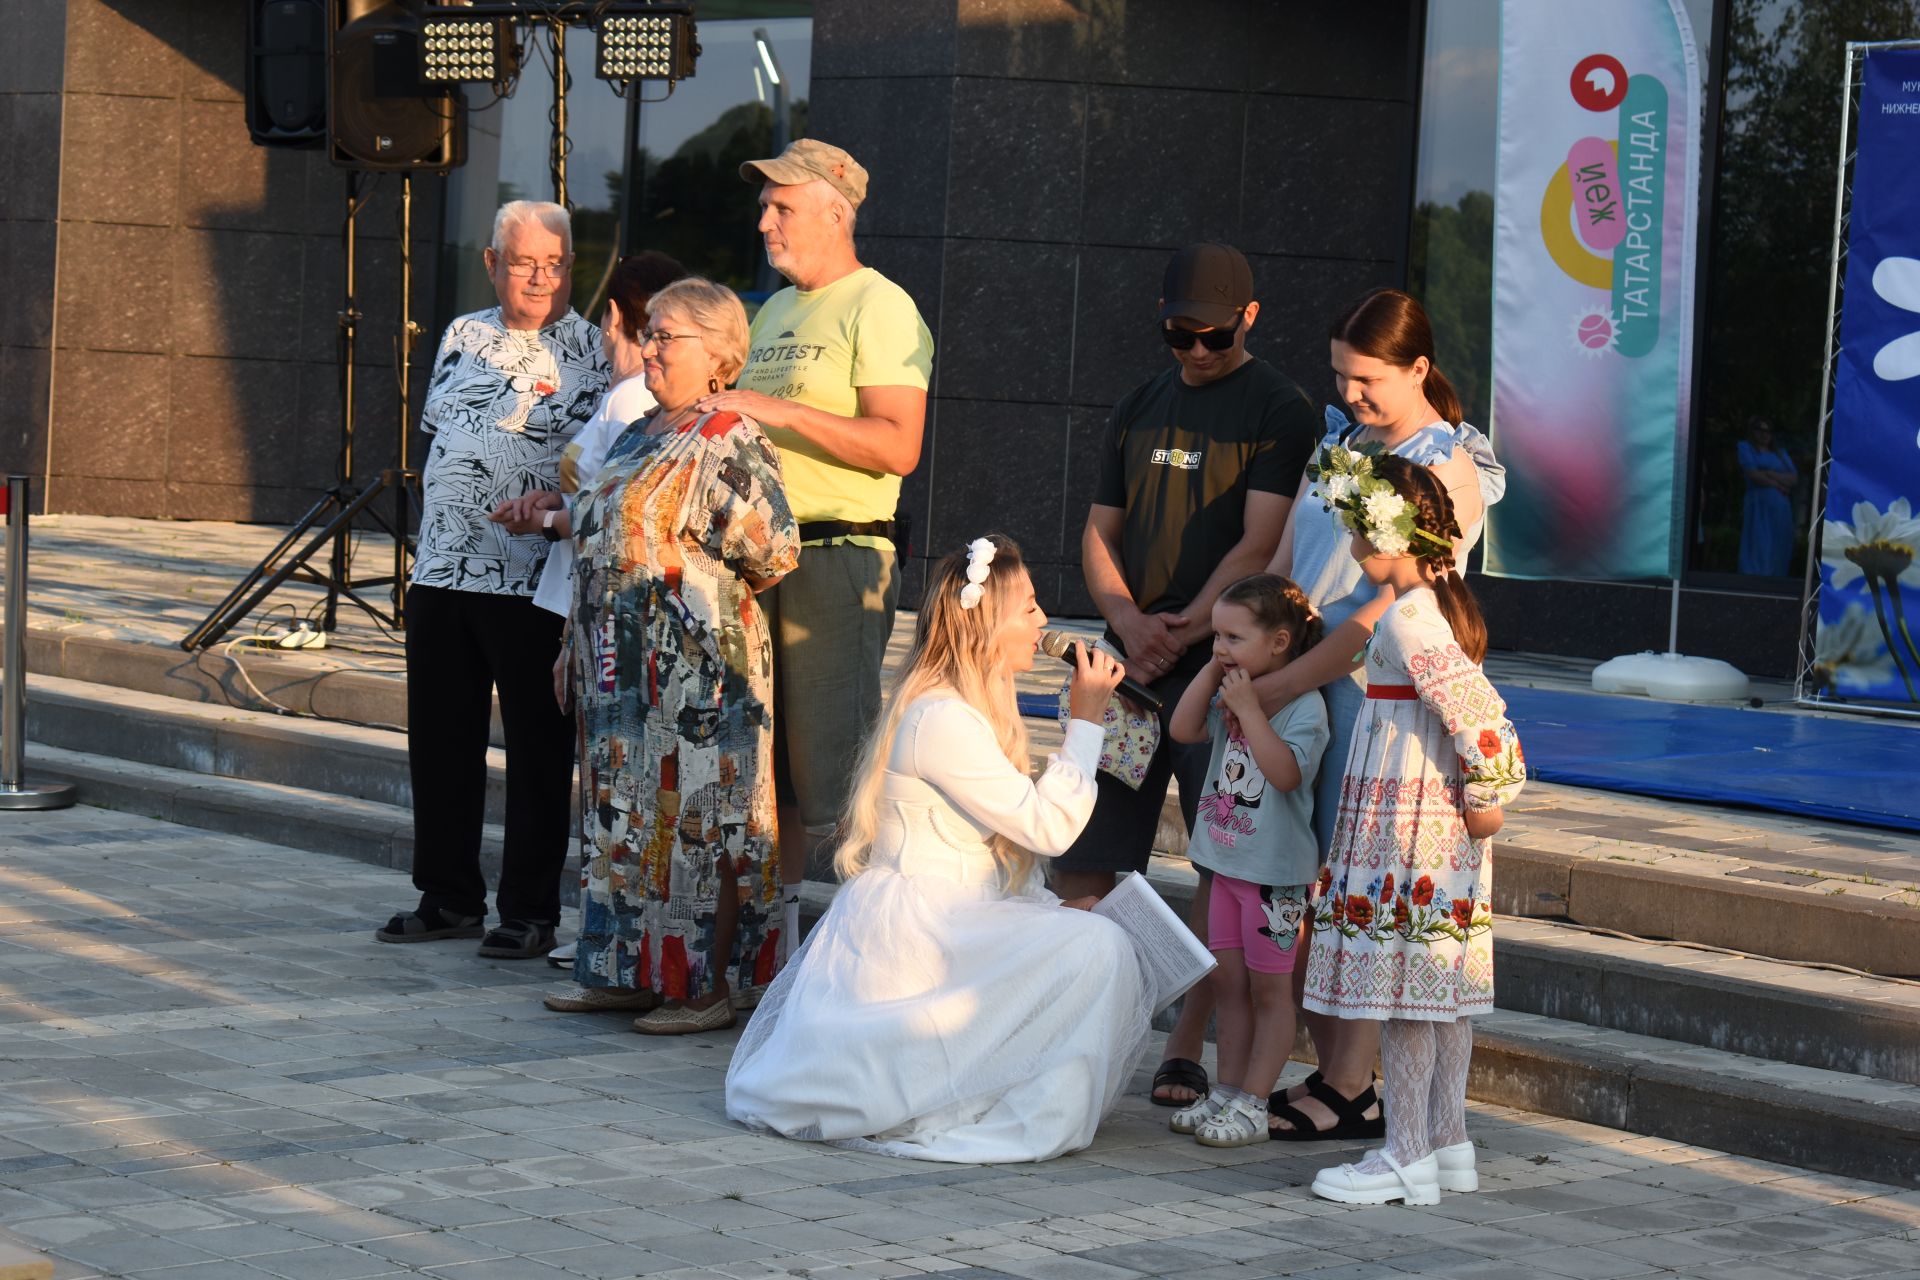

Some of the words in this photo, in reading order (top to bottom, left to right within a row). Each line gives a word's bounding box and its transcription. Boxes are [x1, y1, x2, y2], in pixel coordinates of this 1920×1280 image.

[1902, 81, 1920, 92] МУ
[1881, 103, 1920, 114] НИЖНЕ
[1623, 110, 1661, 322] ТАТАРСТАНДА
[752, 373, 785, 382] COMPANY
